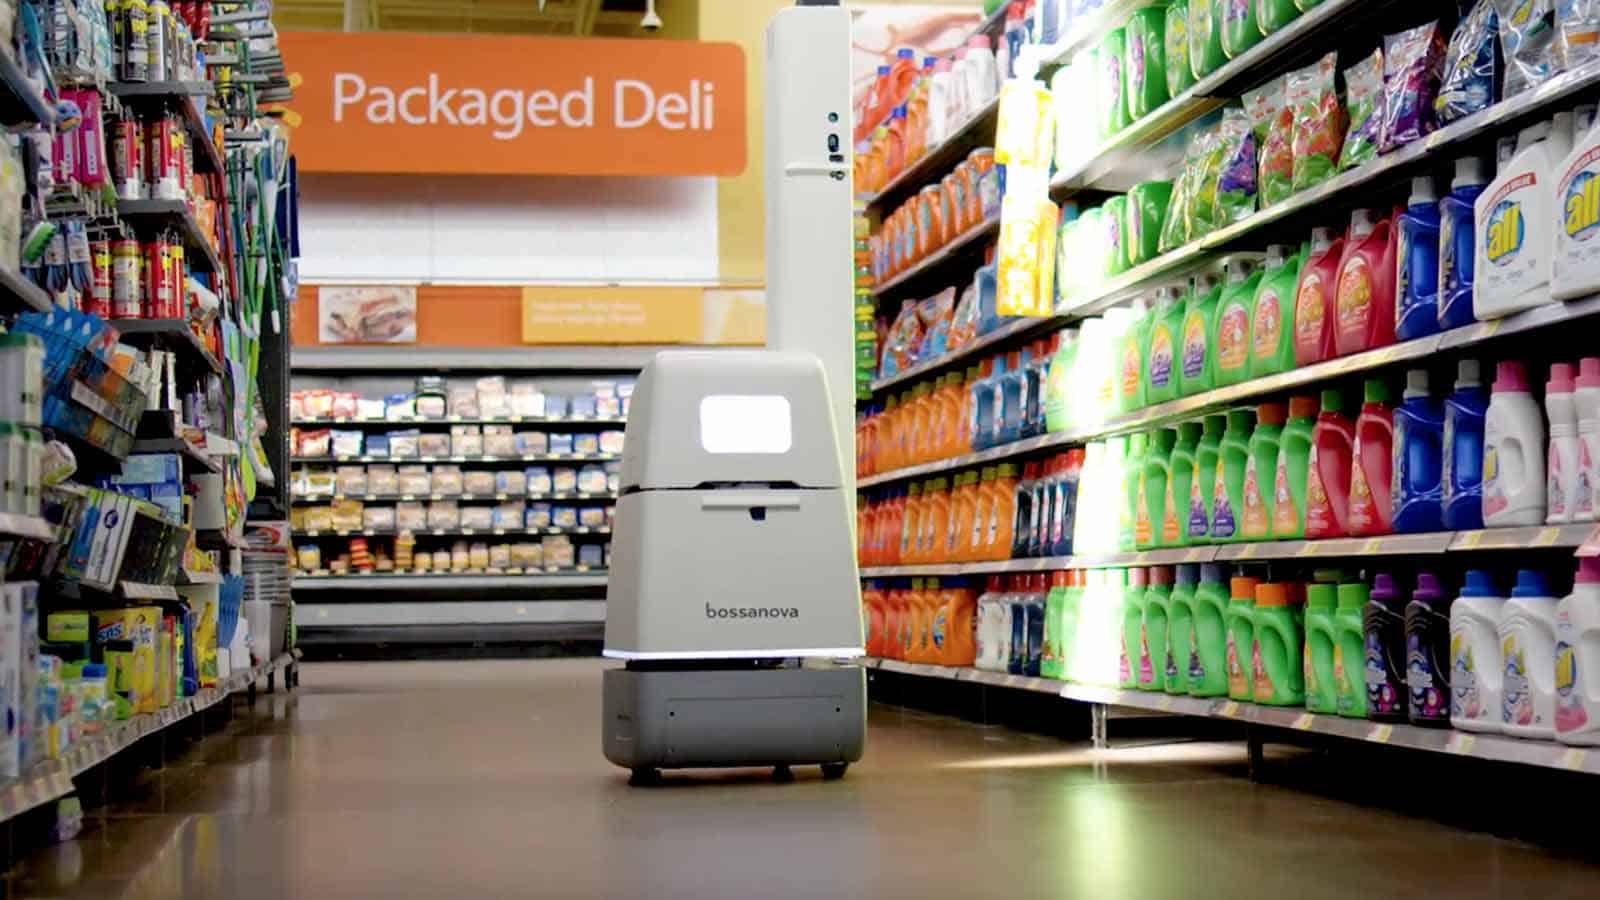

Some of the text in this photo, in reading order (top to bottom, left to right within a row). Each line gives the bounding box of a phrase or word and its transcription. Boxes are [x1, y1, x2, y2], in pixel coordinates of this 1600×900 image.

[333, 72, 714, 140] Packaged Deli
[1487, 202, 1521, 262] all
[705, 600, 800, 619] bossanova
